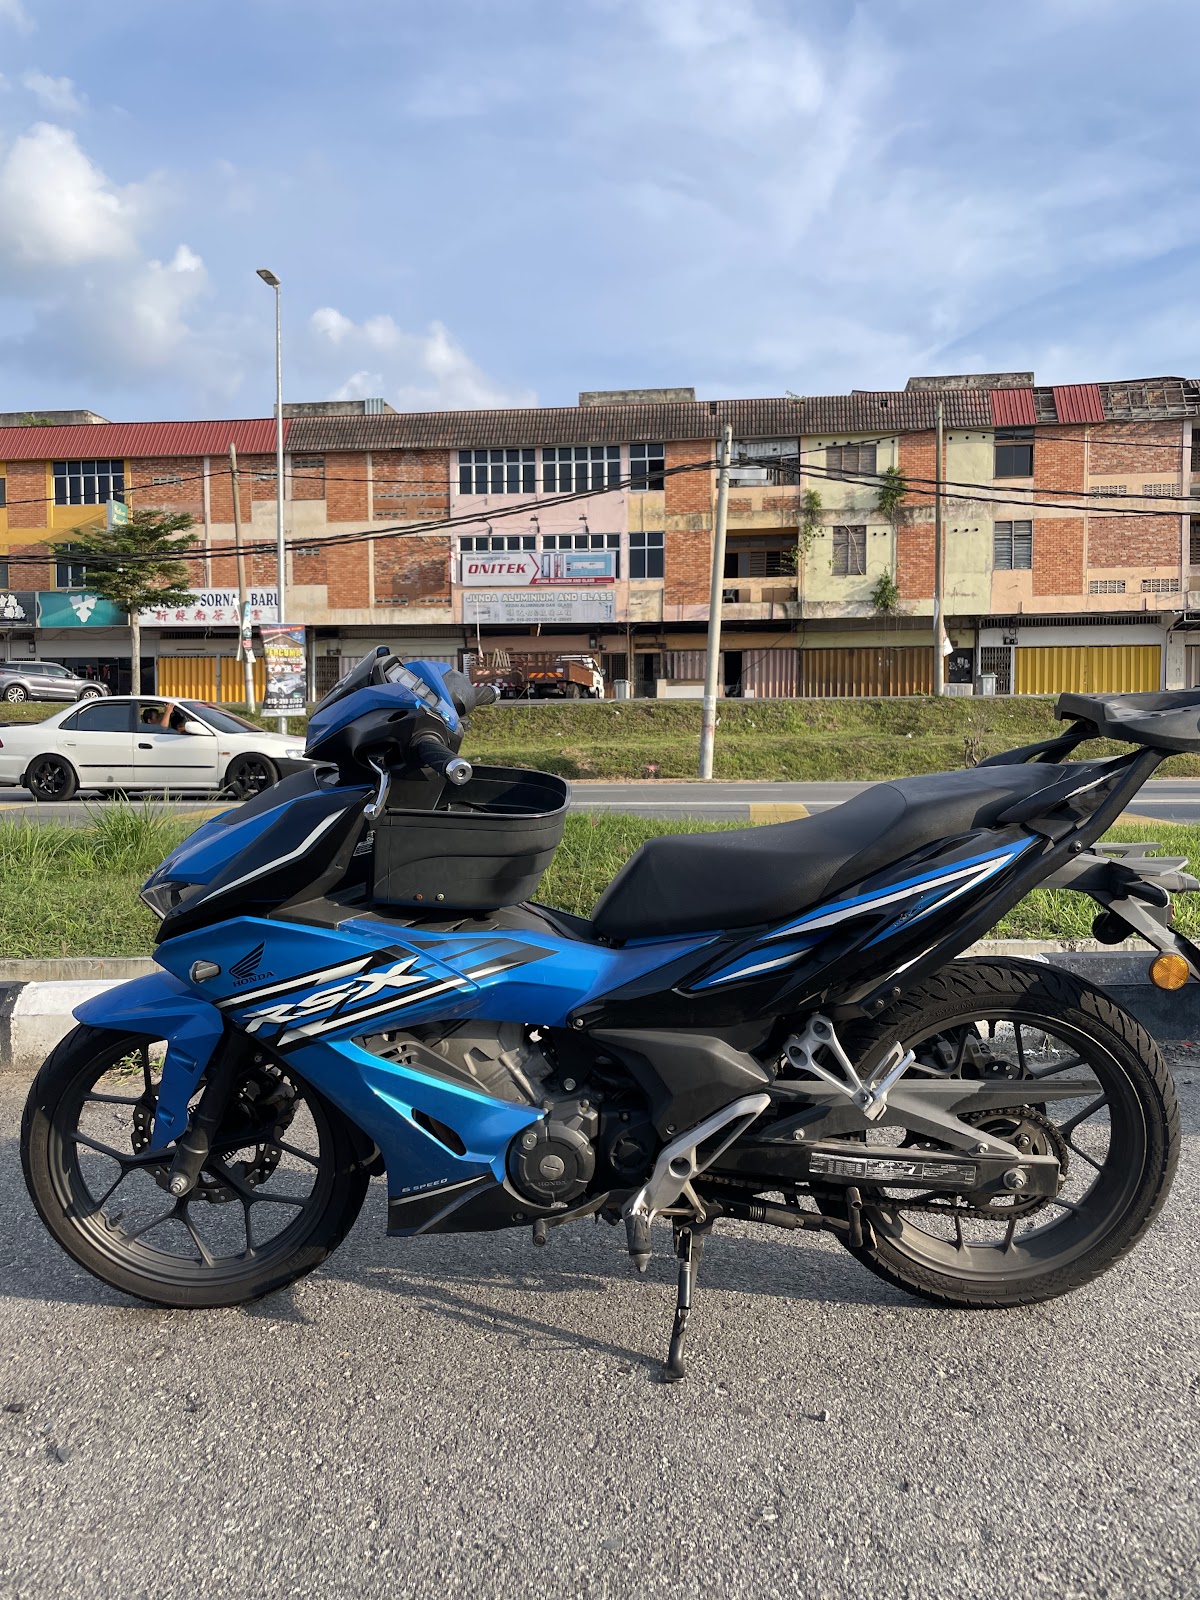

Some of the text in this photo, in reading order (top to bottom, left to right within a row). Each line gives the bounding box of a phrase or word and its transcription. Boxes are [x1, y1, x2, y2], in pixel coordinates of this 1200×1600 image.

[468, 563, 526, 574] ONITEK
[466, 592, 613, 603] JUNDA ALUMINIUM AND GLASS
[232, 971, 274, 988] HONDA
[413, 1178, 448, 1191] SPEED
[537, 1180, 568, 1188] HONDA
